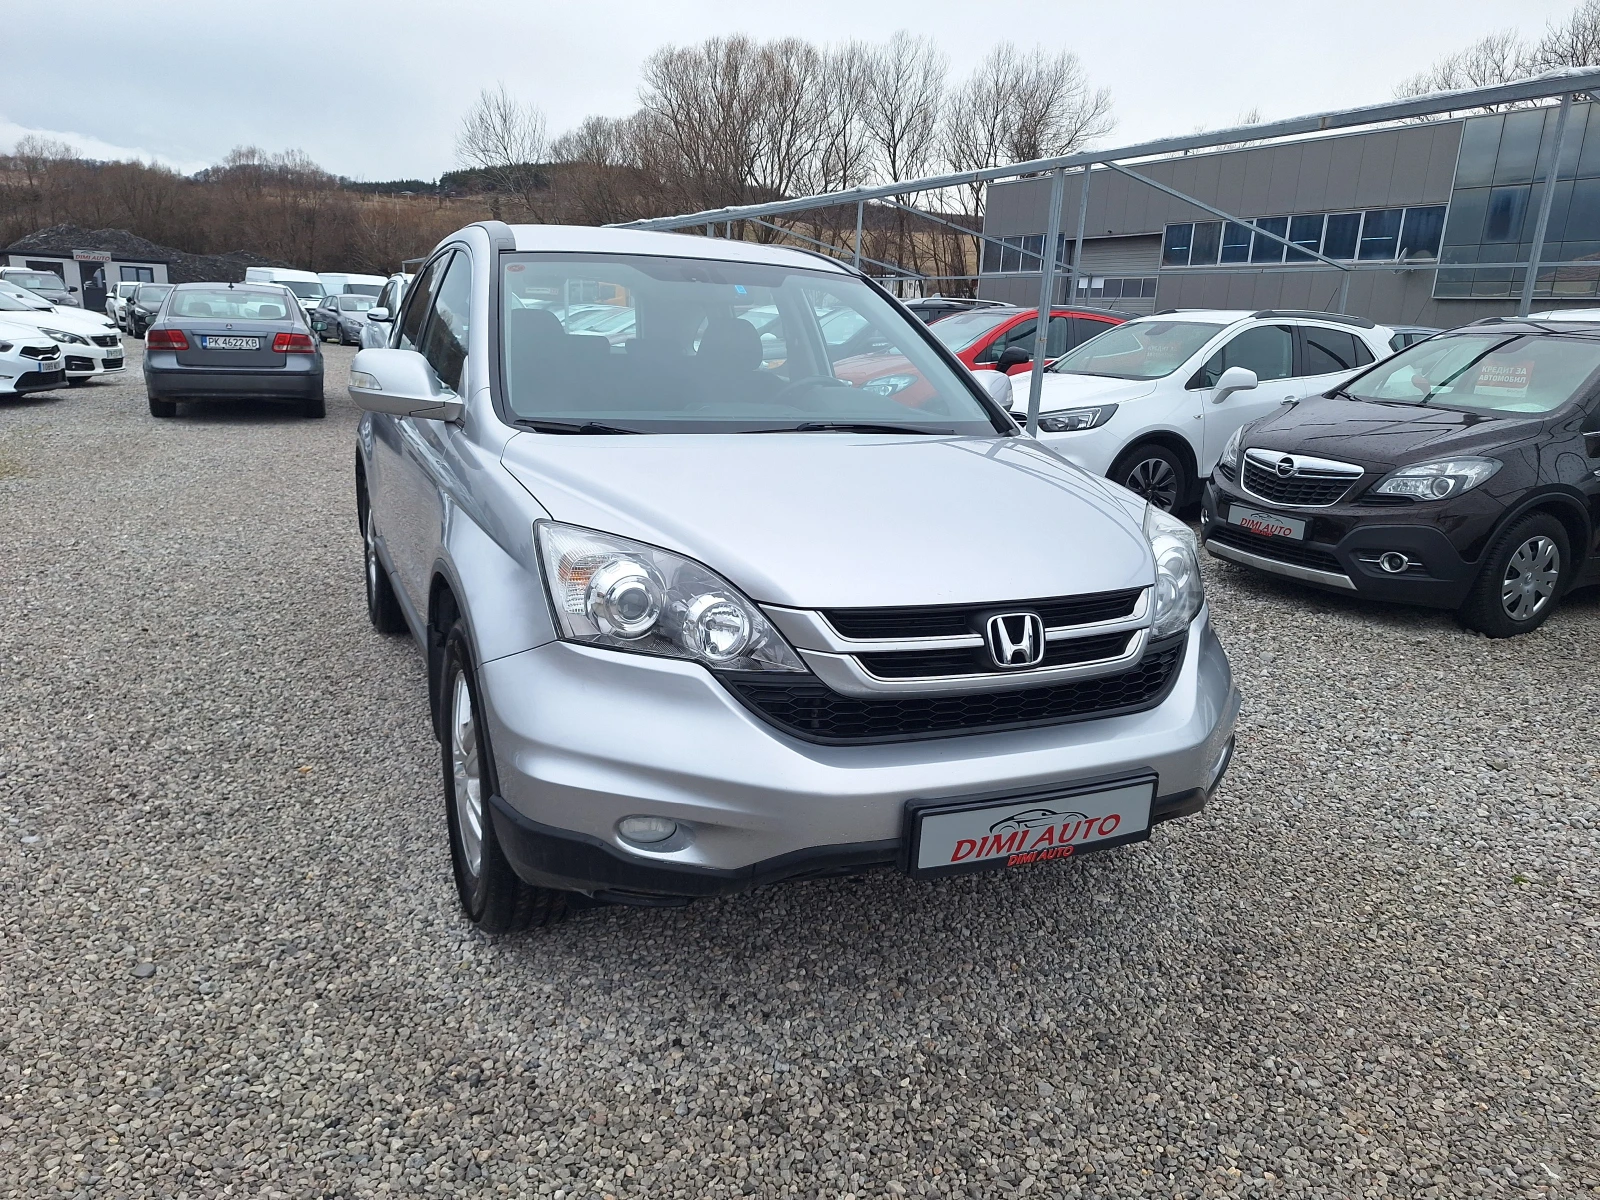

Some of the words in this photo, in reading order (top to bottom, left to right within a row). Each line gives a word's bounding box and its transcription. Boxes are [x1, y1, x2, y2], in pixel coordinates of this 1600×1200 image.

[208, 337, 220, 346] PK
[222, 338, 244, 347] 4622
[245, 338, 258, 348] KB
[1481, 365, 1514, 375] КРЕДИТ
[1515, 367, 1527, 375] ЗА
[1478, 374, 1526, 383] АВТОМОБИЛ
[1240, 517, 1263, 530] DIMI
[1261, 523, 1292, 536] AUTO
[950, 829, 1031, 862] DIMI
[1030, 813, 1121, 847] AUTO
[1007, 850, 1038, 867] DIMI
[1036, 845, 1075, 862] AUTO
